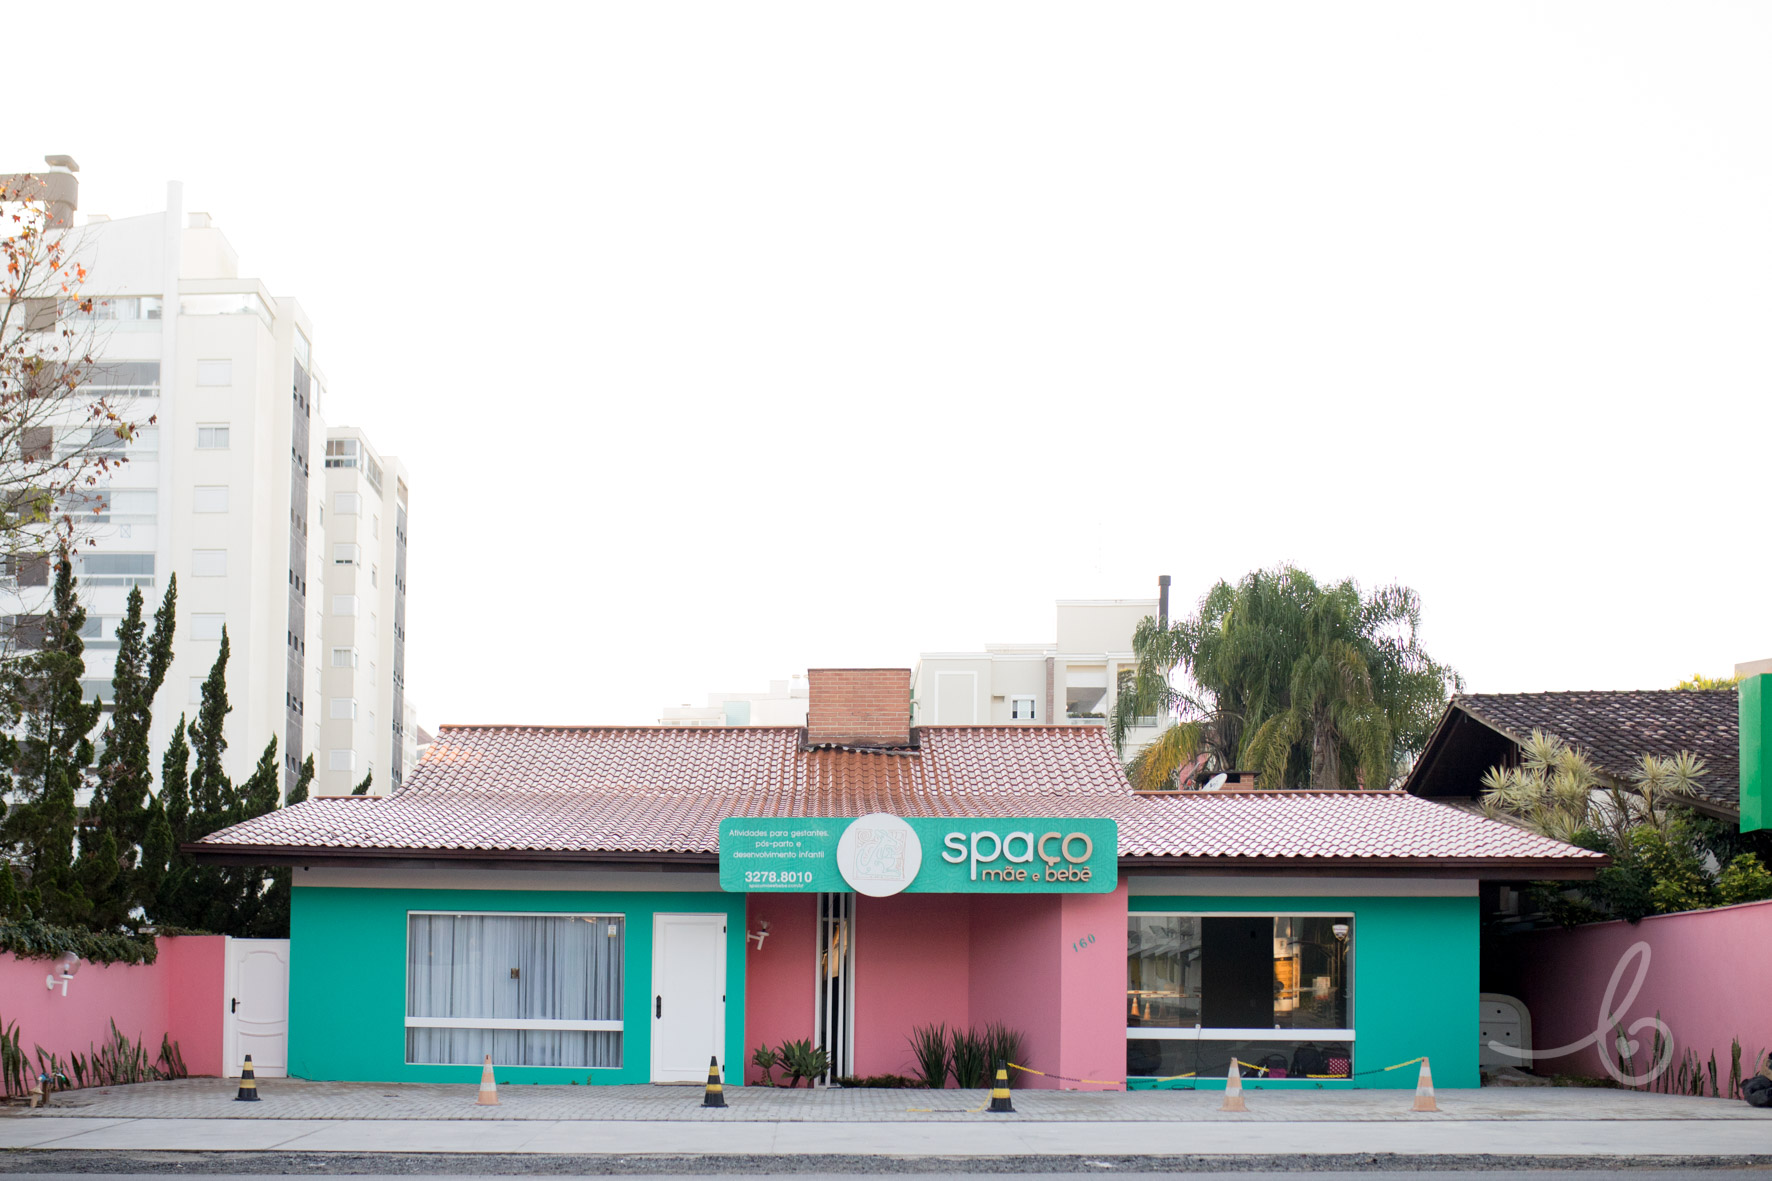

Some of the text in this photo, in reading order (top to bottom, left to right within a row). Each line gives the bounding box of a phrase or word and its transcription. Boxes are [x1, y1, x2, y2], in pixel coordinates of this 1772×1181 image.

[729, 829, 767, 837] Atividades
[755, 840, 794, 848] pós-parto
[941, 830, 1093, 881] spaço
[745, 871, 812, 883] 3278.8010
[982, 865, 1092, 882] mãe e bebê
[1072, 933, 1096, 952] 160
